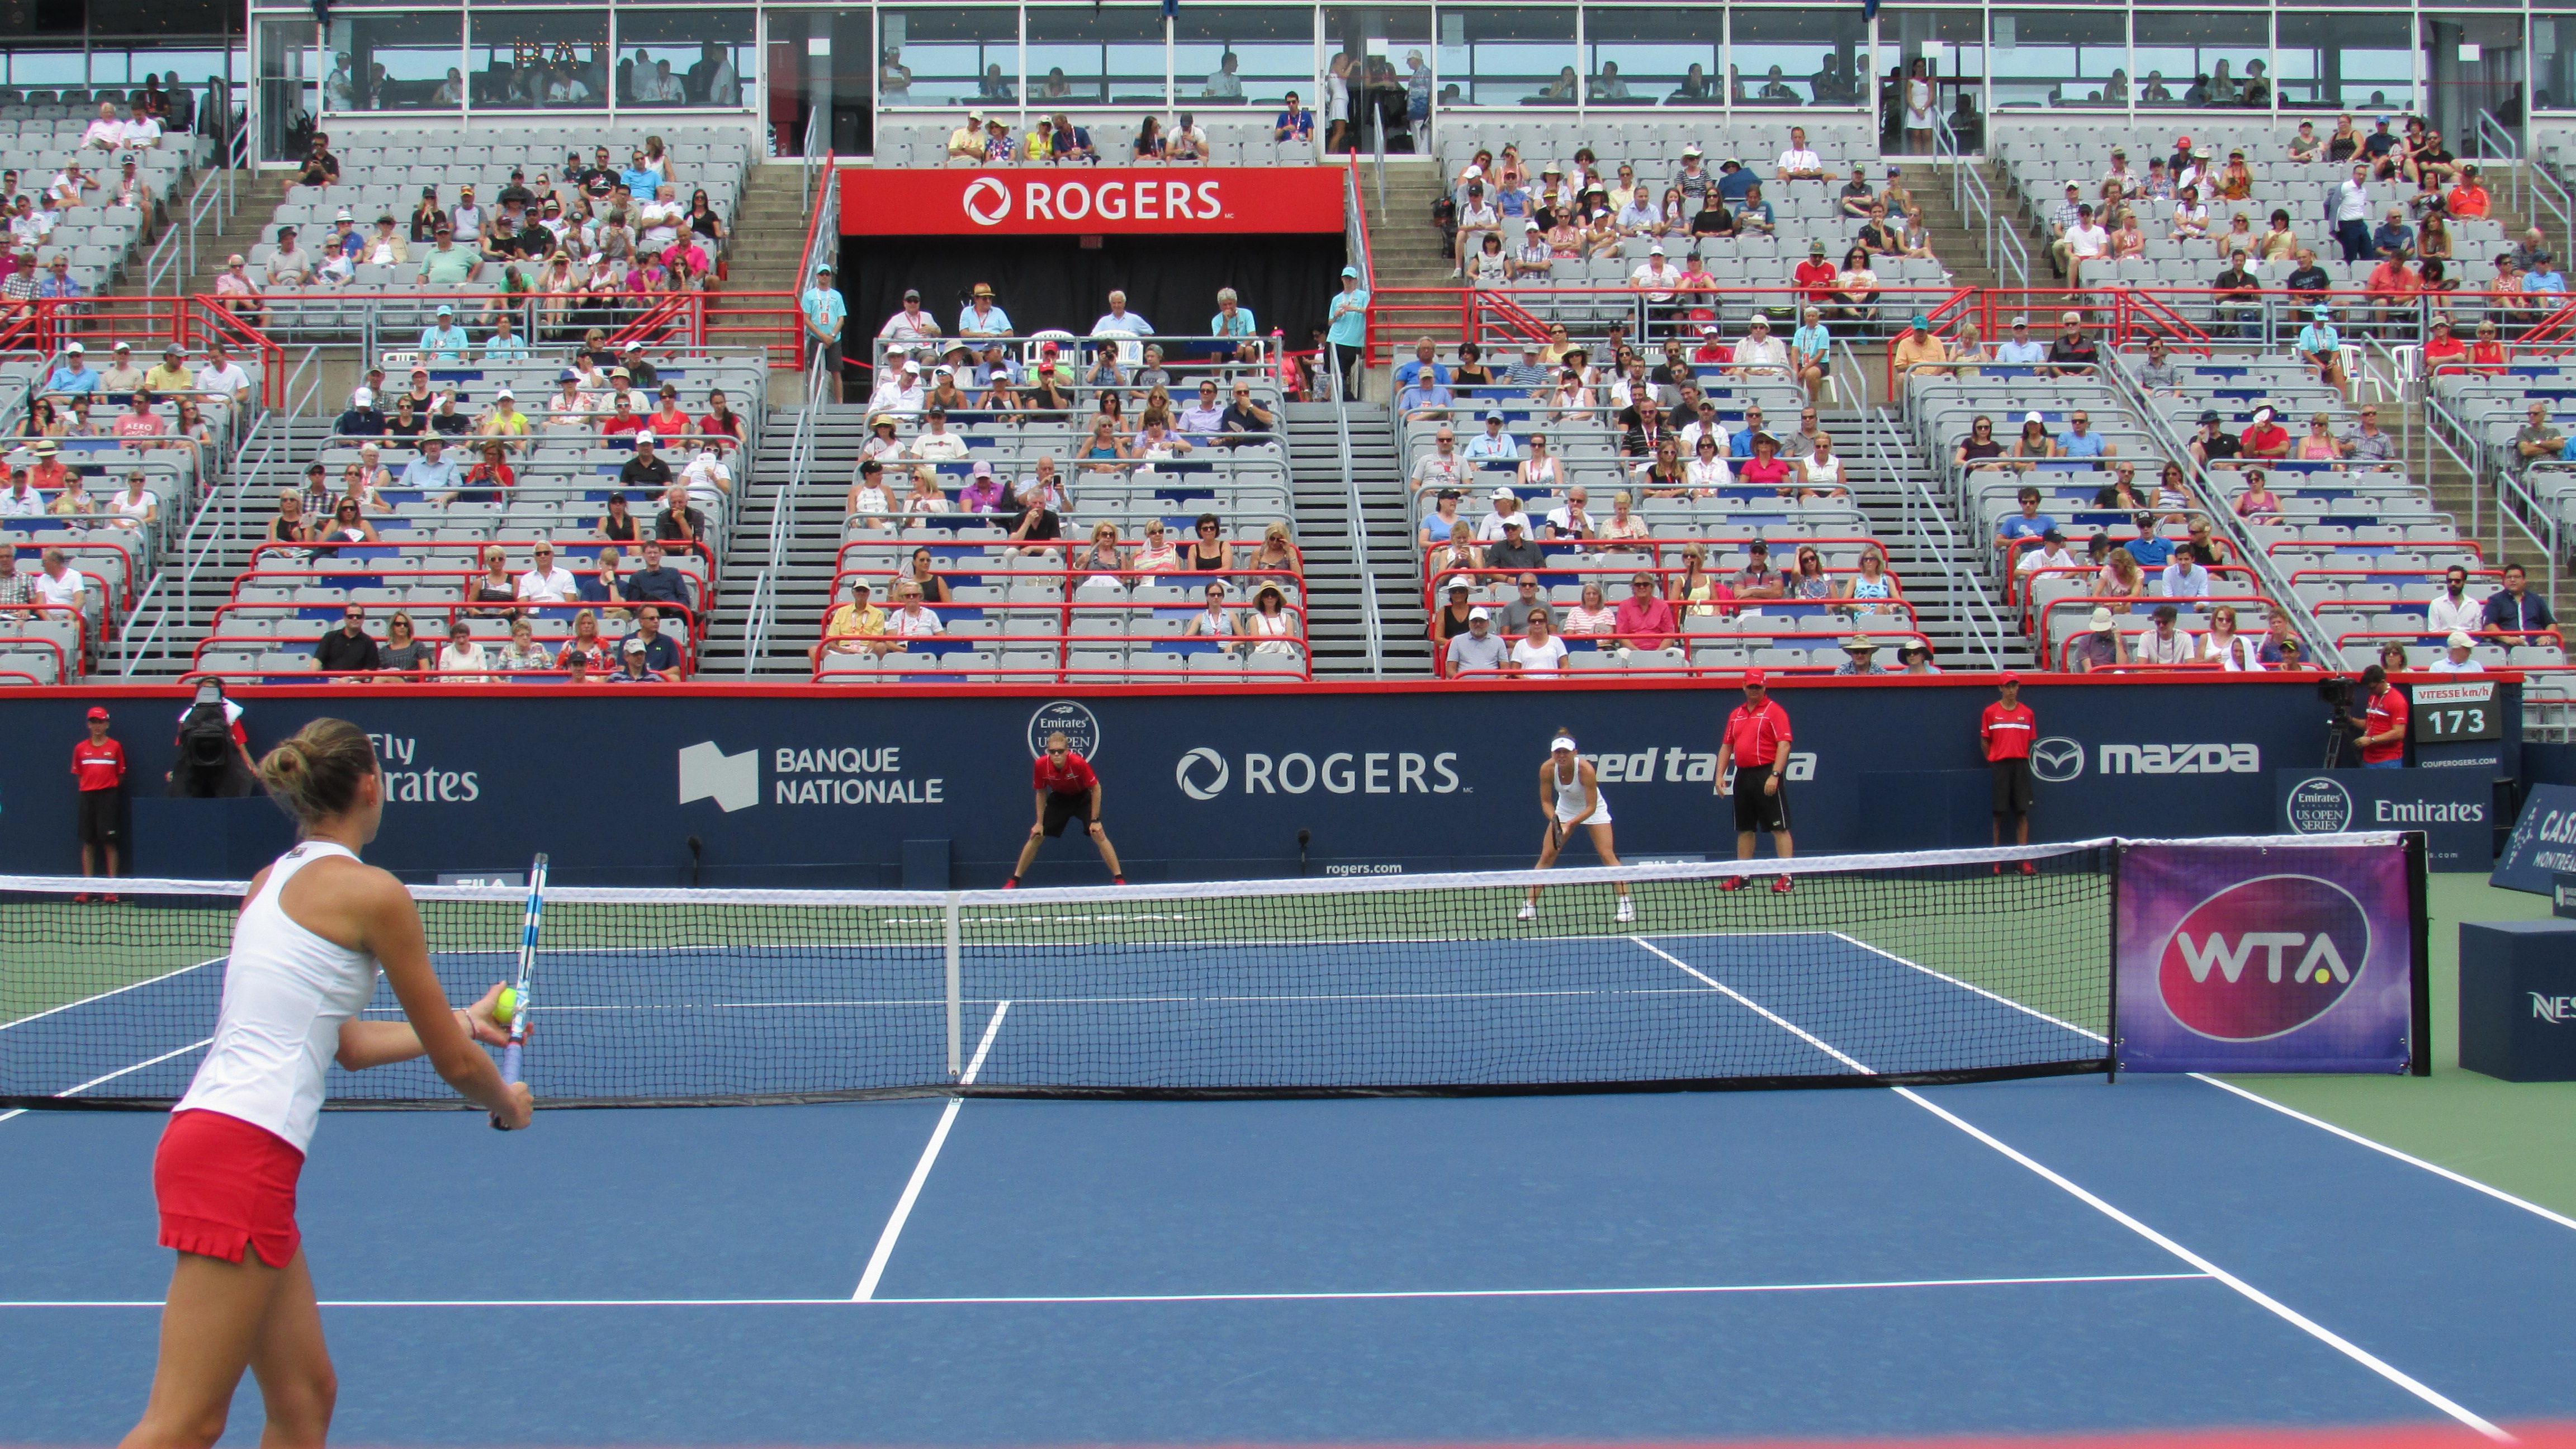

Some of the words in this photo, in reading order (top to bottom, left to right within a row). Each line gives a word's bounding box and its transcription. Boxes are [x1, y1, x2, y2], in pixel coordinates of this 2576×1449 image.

[1026, 181, 1221, 220] ROGERS
[2419, 689, 2460, 699] VITESSE
[2463, 686, 2489, 697] km/h
[1040, 718, 1086, 728] Emirates
[2428, 709, 2485, 734] 173
[776, 747, 901, 774] BANQUE
[2422, 758, 2497, 769] COUPEROGERS.COM
[383, 766, 480, 802] rates
[1245, 752, 1459, 794] ROGERS
[776, 779, 944, 804] NATIONALE
[2298, 793, 2340, 803] Emirates
[2296, 810, 2310, 820] US
[2312, 809, 2343, 820] OPEN
[2375, 799, 2484, 823] Emirates
[2302, 820, 2337, 830] SERIES
[1326, 863, 1403, 877] rogers.com
[2177, 932, 2350, 984] WTA
